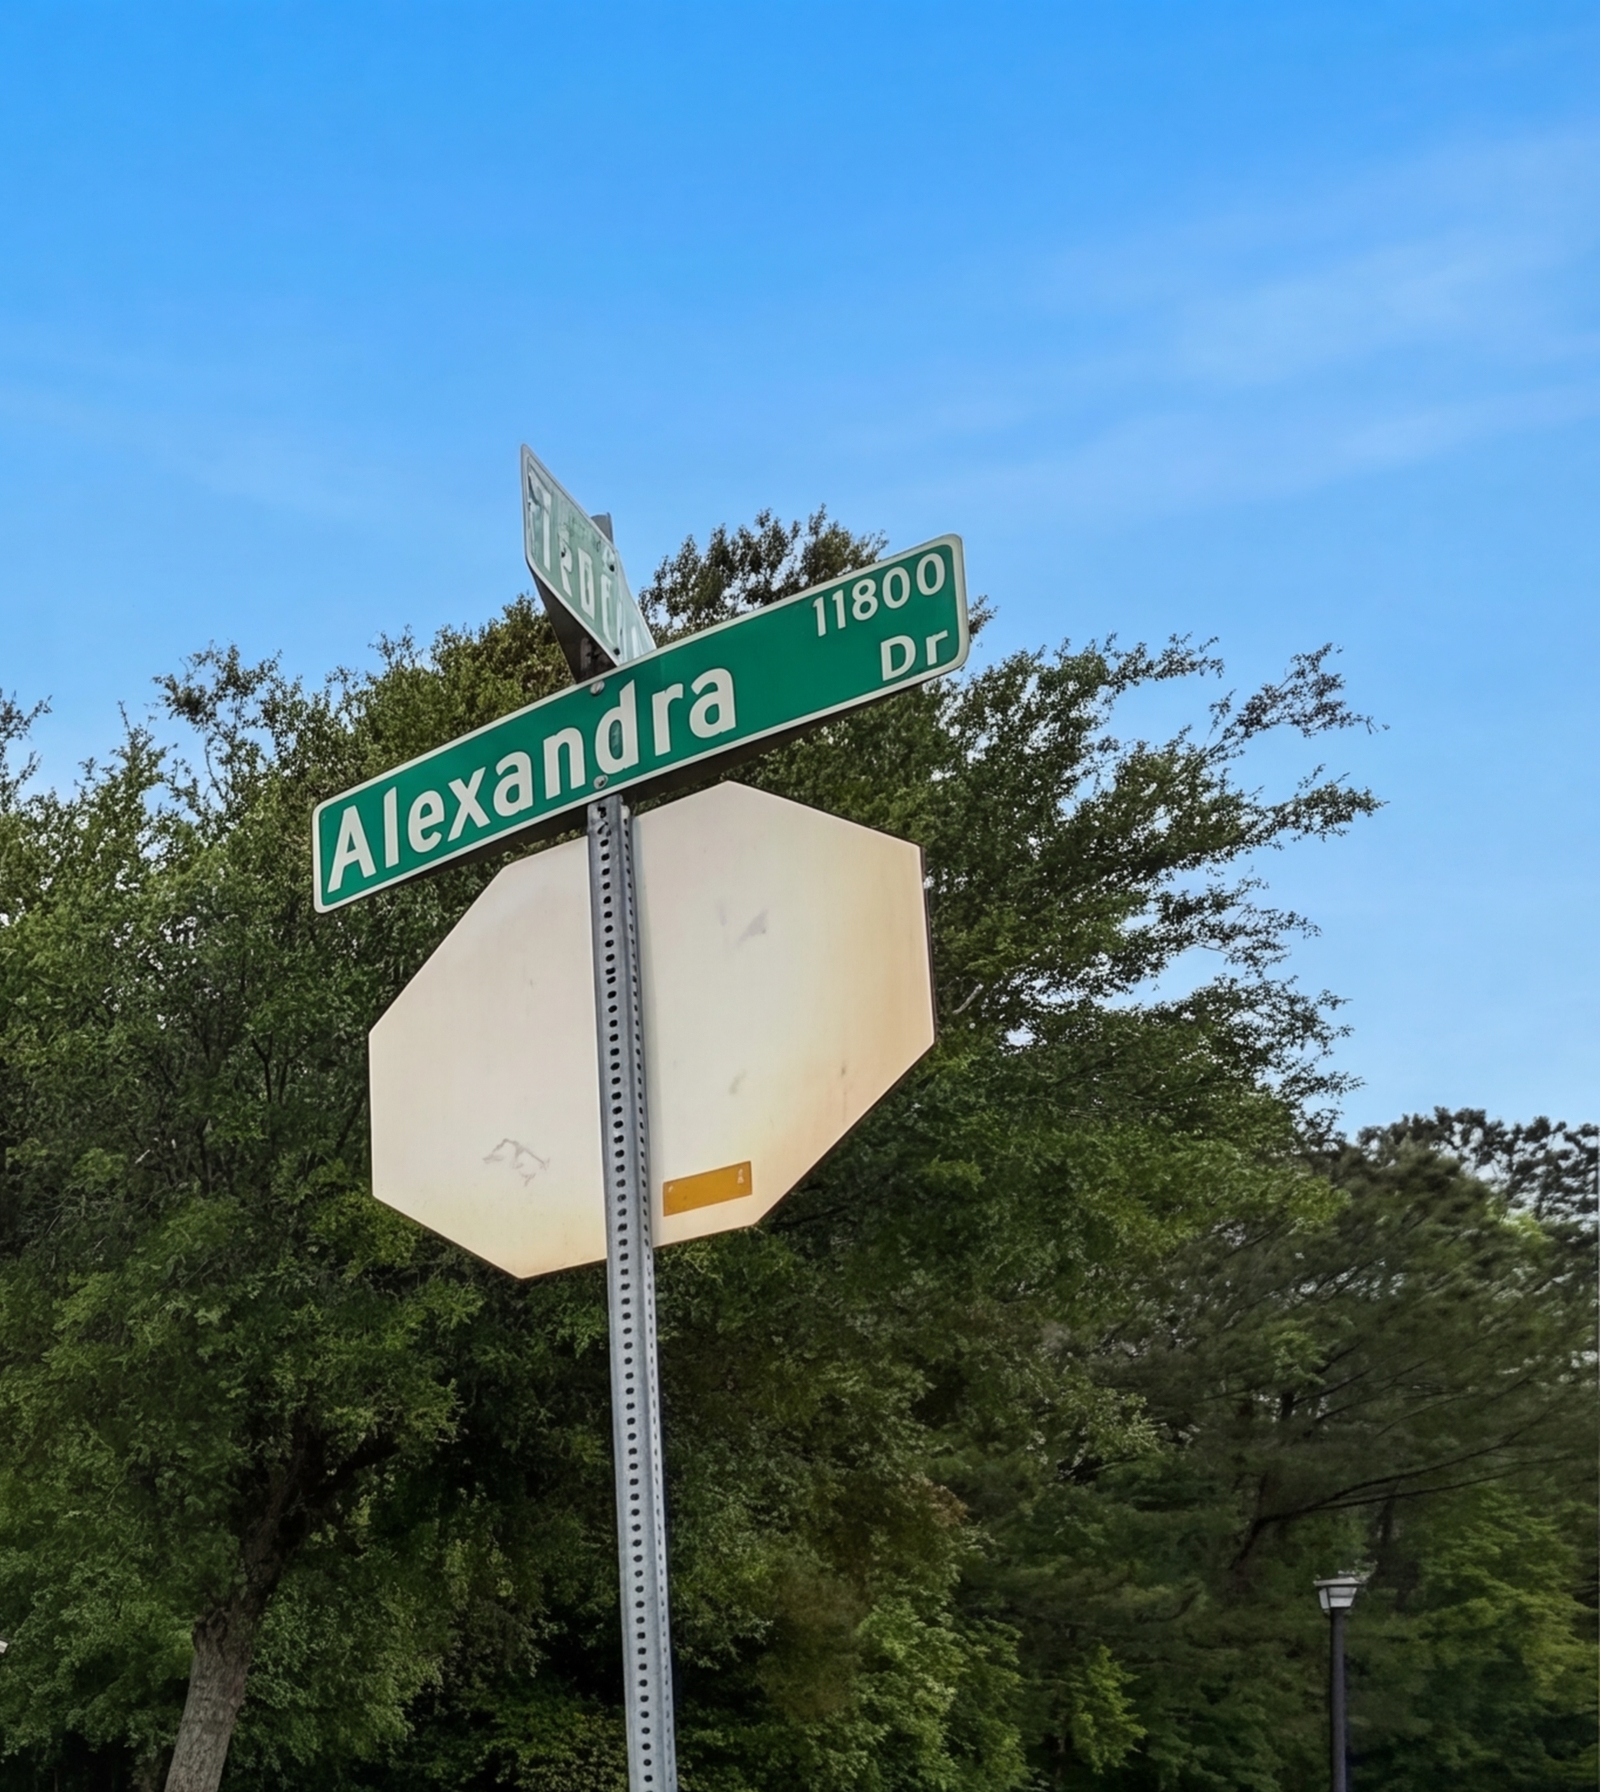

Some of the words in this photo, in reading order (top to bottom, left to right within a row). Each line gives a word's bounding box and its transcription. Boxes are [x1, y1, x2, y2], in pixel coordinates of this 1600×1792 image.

[813, 552, 946, 638] 11800
[327, 668, 737, 894] Alexandra
[880, 629, 949, 682] Dr
